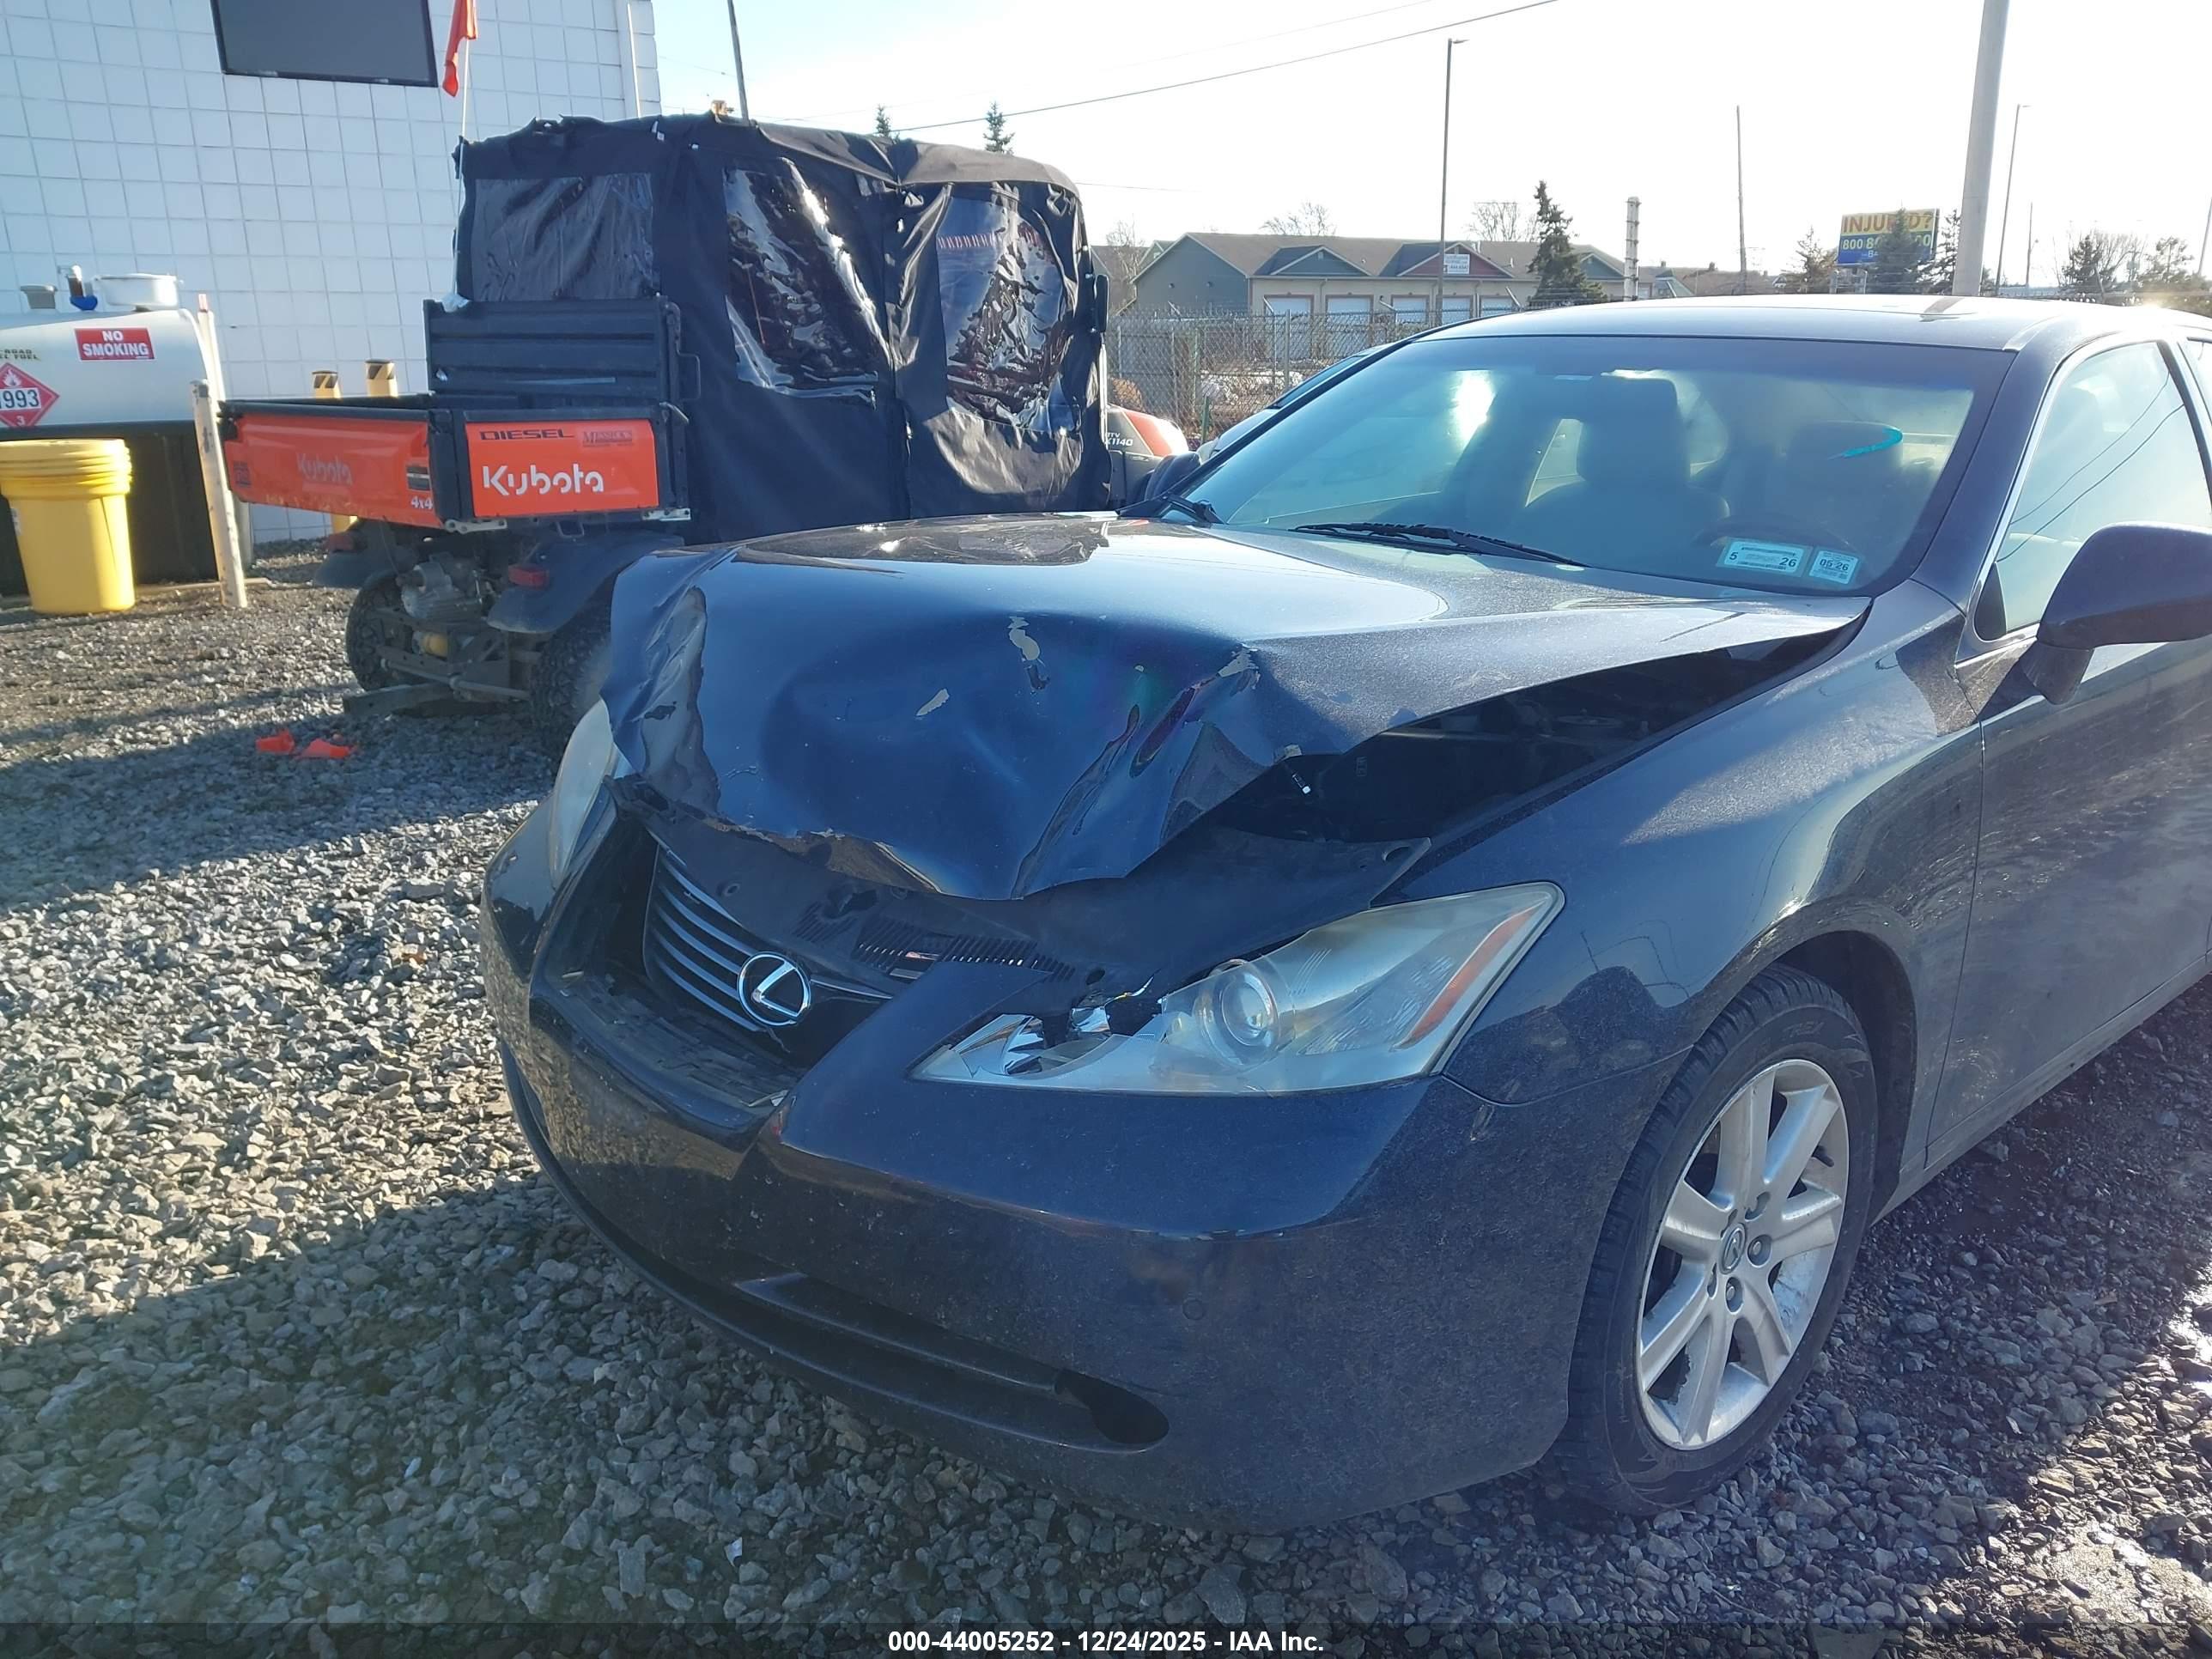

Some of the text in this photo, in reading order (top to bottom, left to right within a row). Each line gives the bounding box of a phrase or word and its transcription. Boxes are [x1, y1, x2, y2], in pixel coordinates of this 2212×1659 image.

[102, 330, 124, 342] NO
[82, 343, 149, 356] SMOKING
[16, 415, 26, 427] 3
[479, 428, 574, 441] DIESEL
[296, 453, 353, 487] Kubota
[482, 463, 605, 495] Kubota
[410, 495, 434, 510] 4x4
[1729, 551, 1739, 561] 5
[1778, 556, 1797, 568] 26
